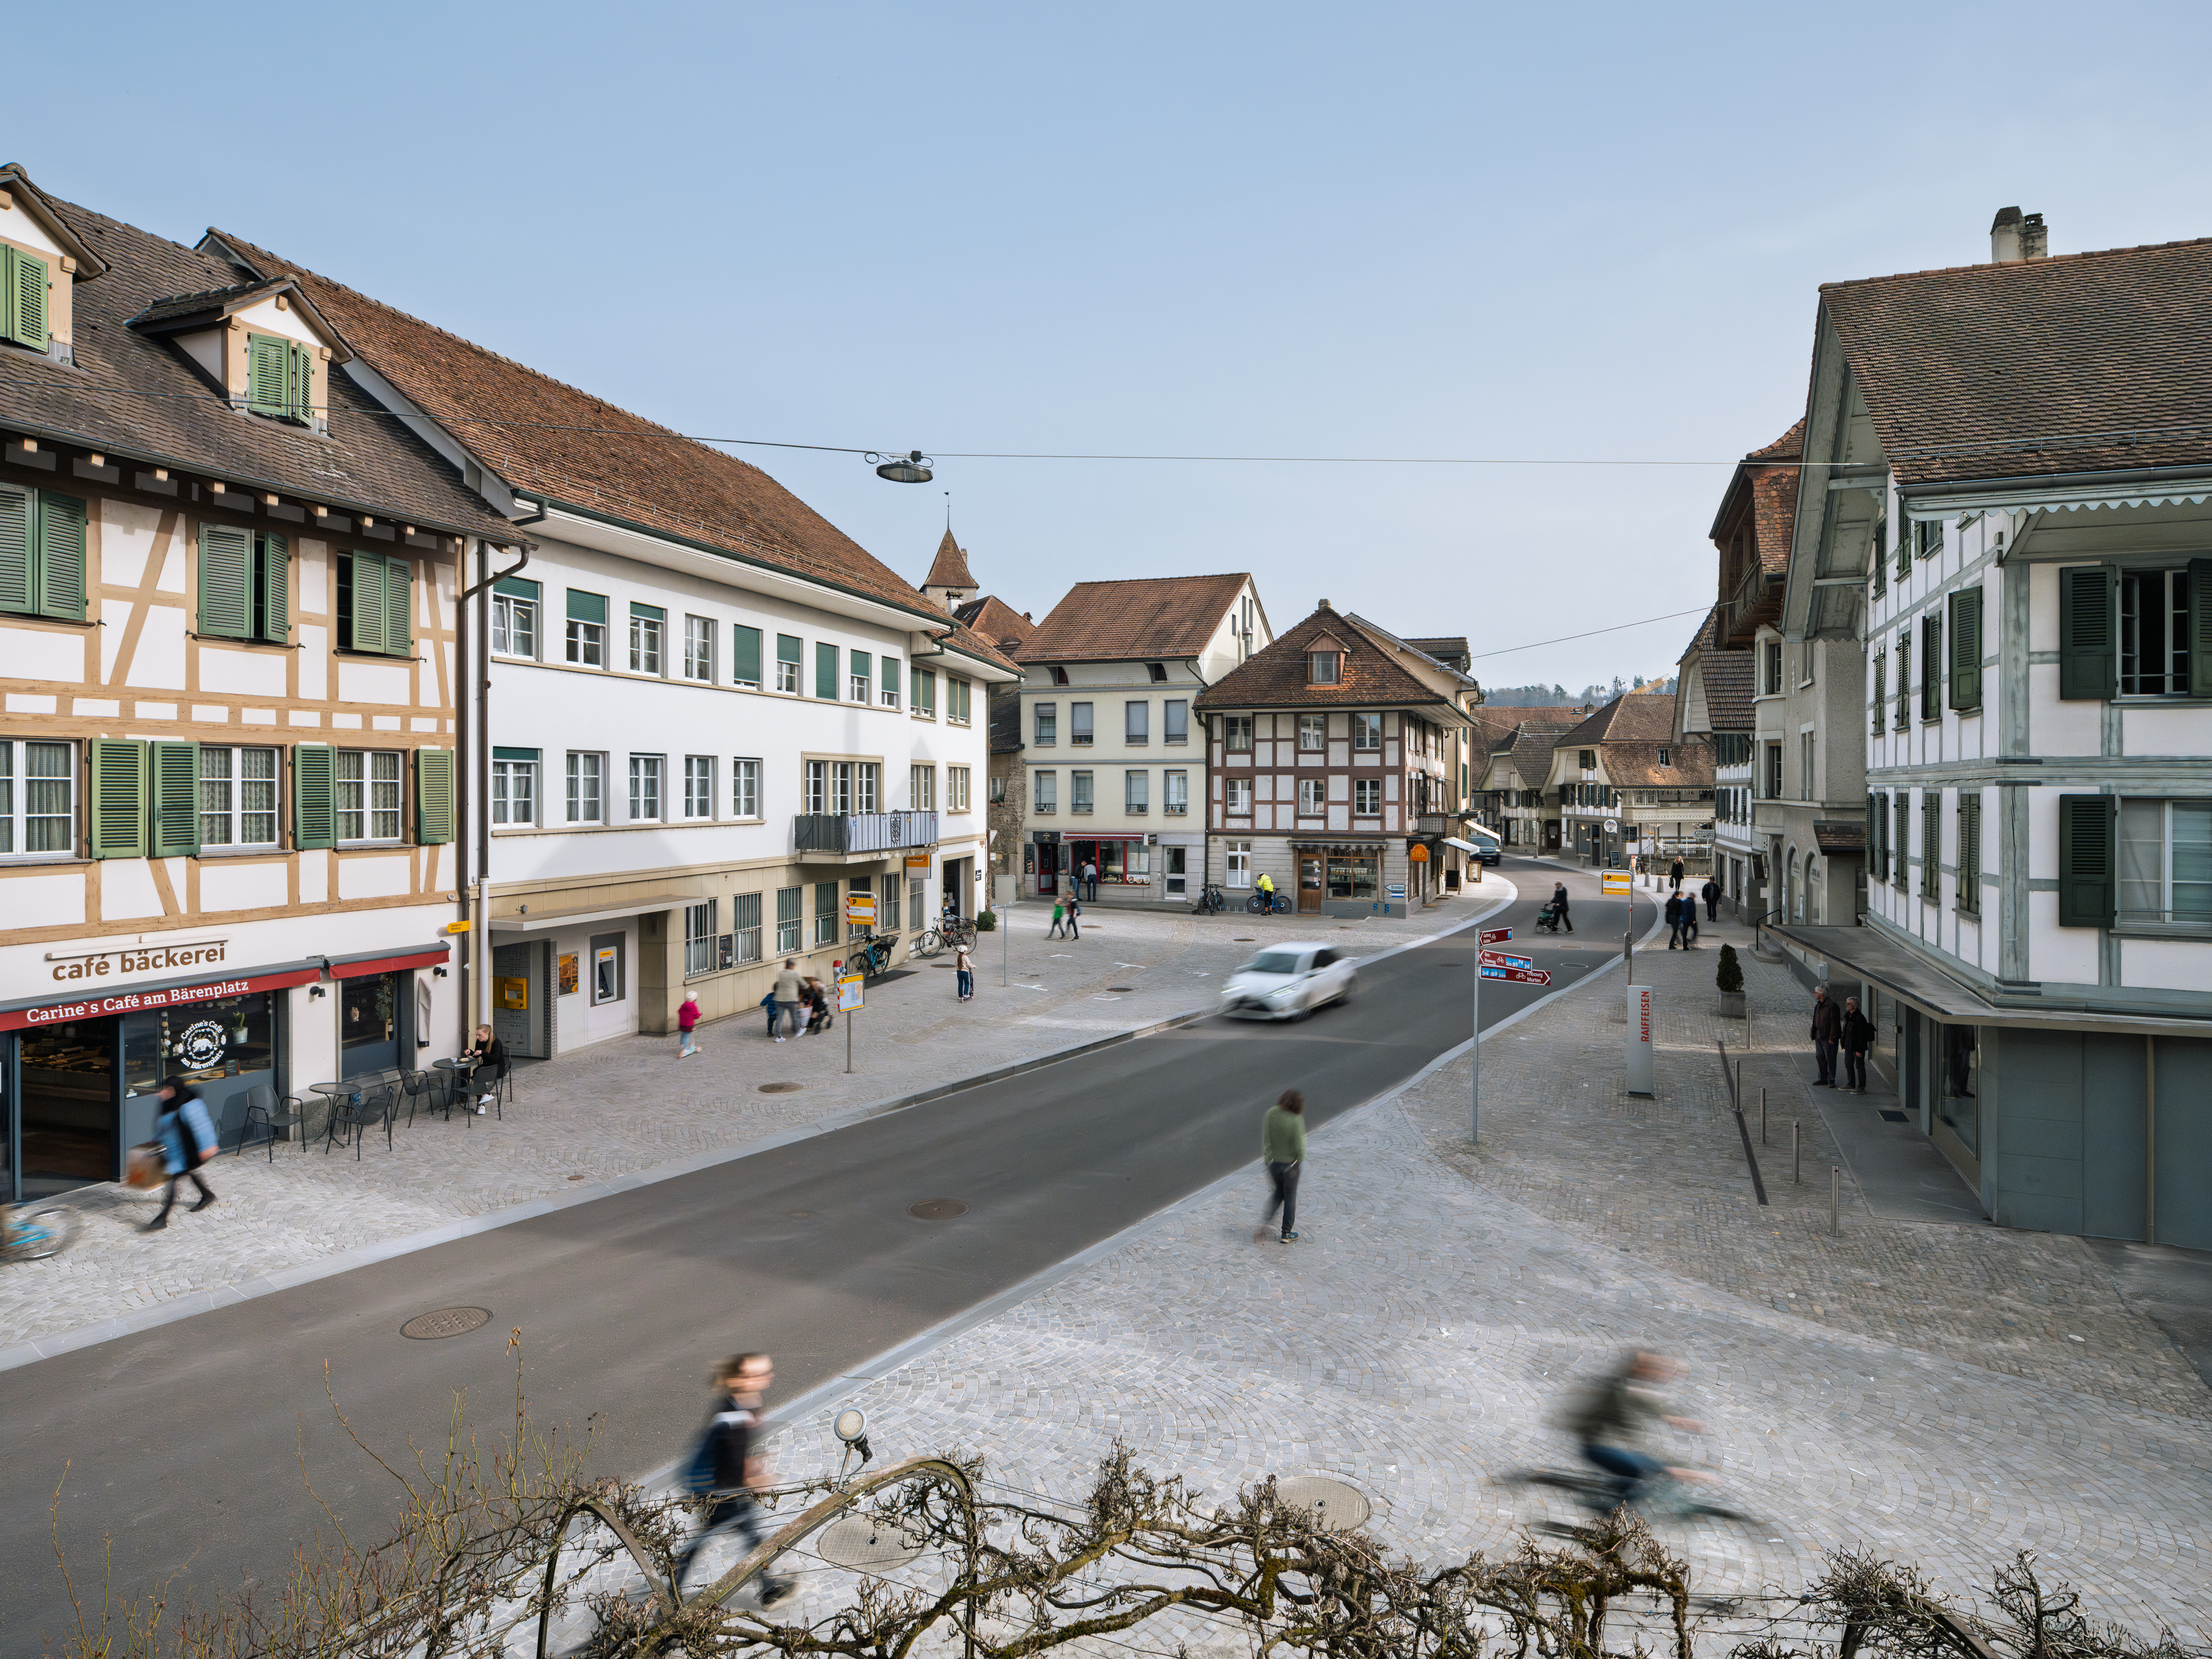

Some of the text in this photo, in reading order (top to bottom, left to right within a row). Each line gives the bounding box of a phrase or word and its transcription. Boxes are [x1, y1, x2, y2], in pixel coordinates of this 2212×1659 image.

[52, 943, 225, 981] café bäckerei
[103, 995, 140, 1012] Café
[144, 992, 167, 1006] am
[170, 981, 249, 1002] Bärenplatz
[180, 1020, 224, 1040] Carine's Café
[1641, 991, 1649, 1042] RAIFFEISEN
[180, 1057, 191, 1067] am
[190, 1049, 224, 1070] Bärenplatz
